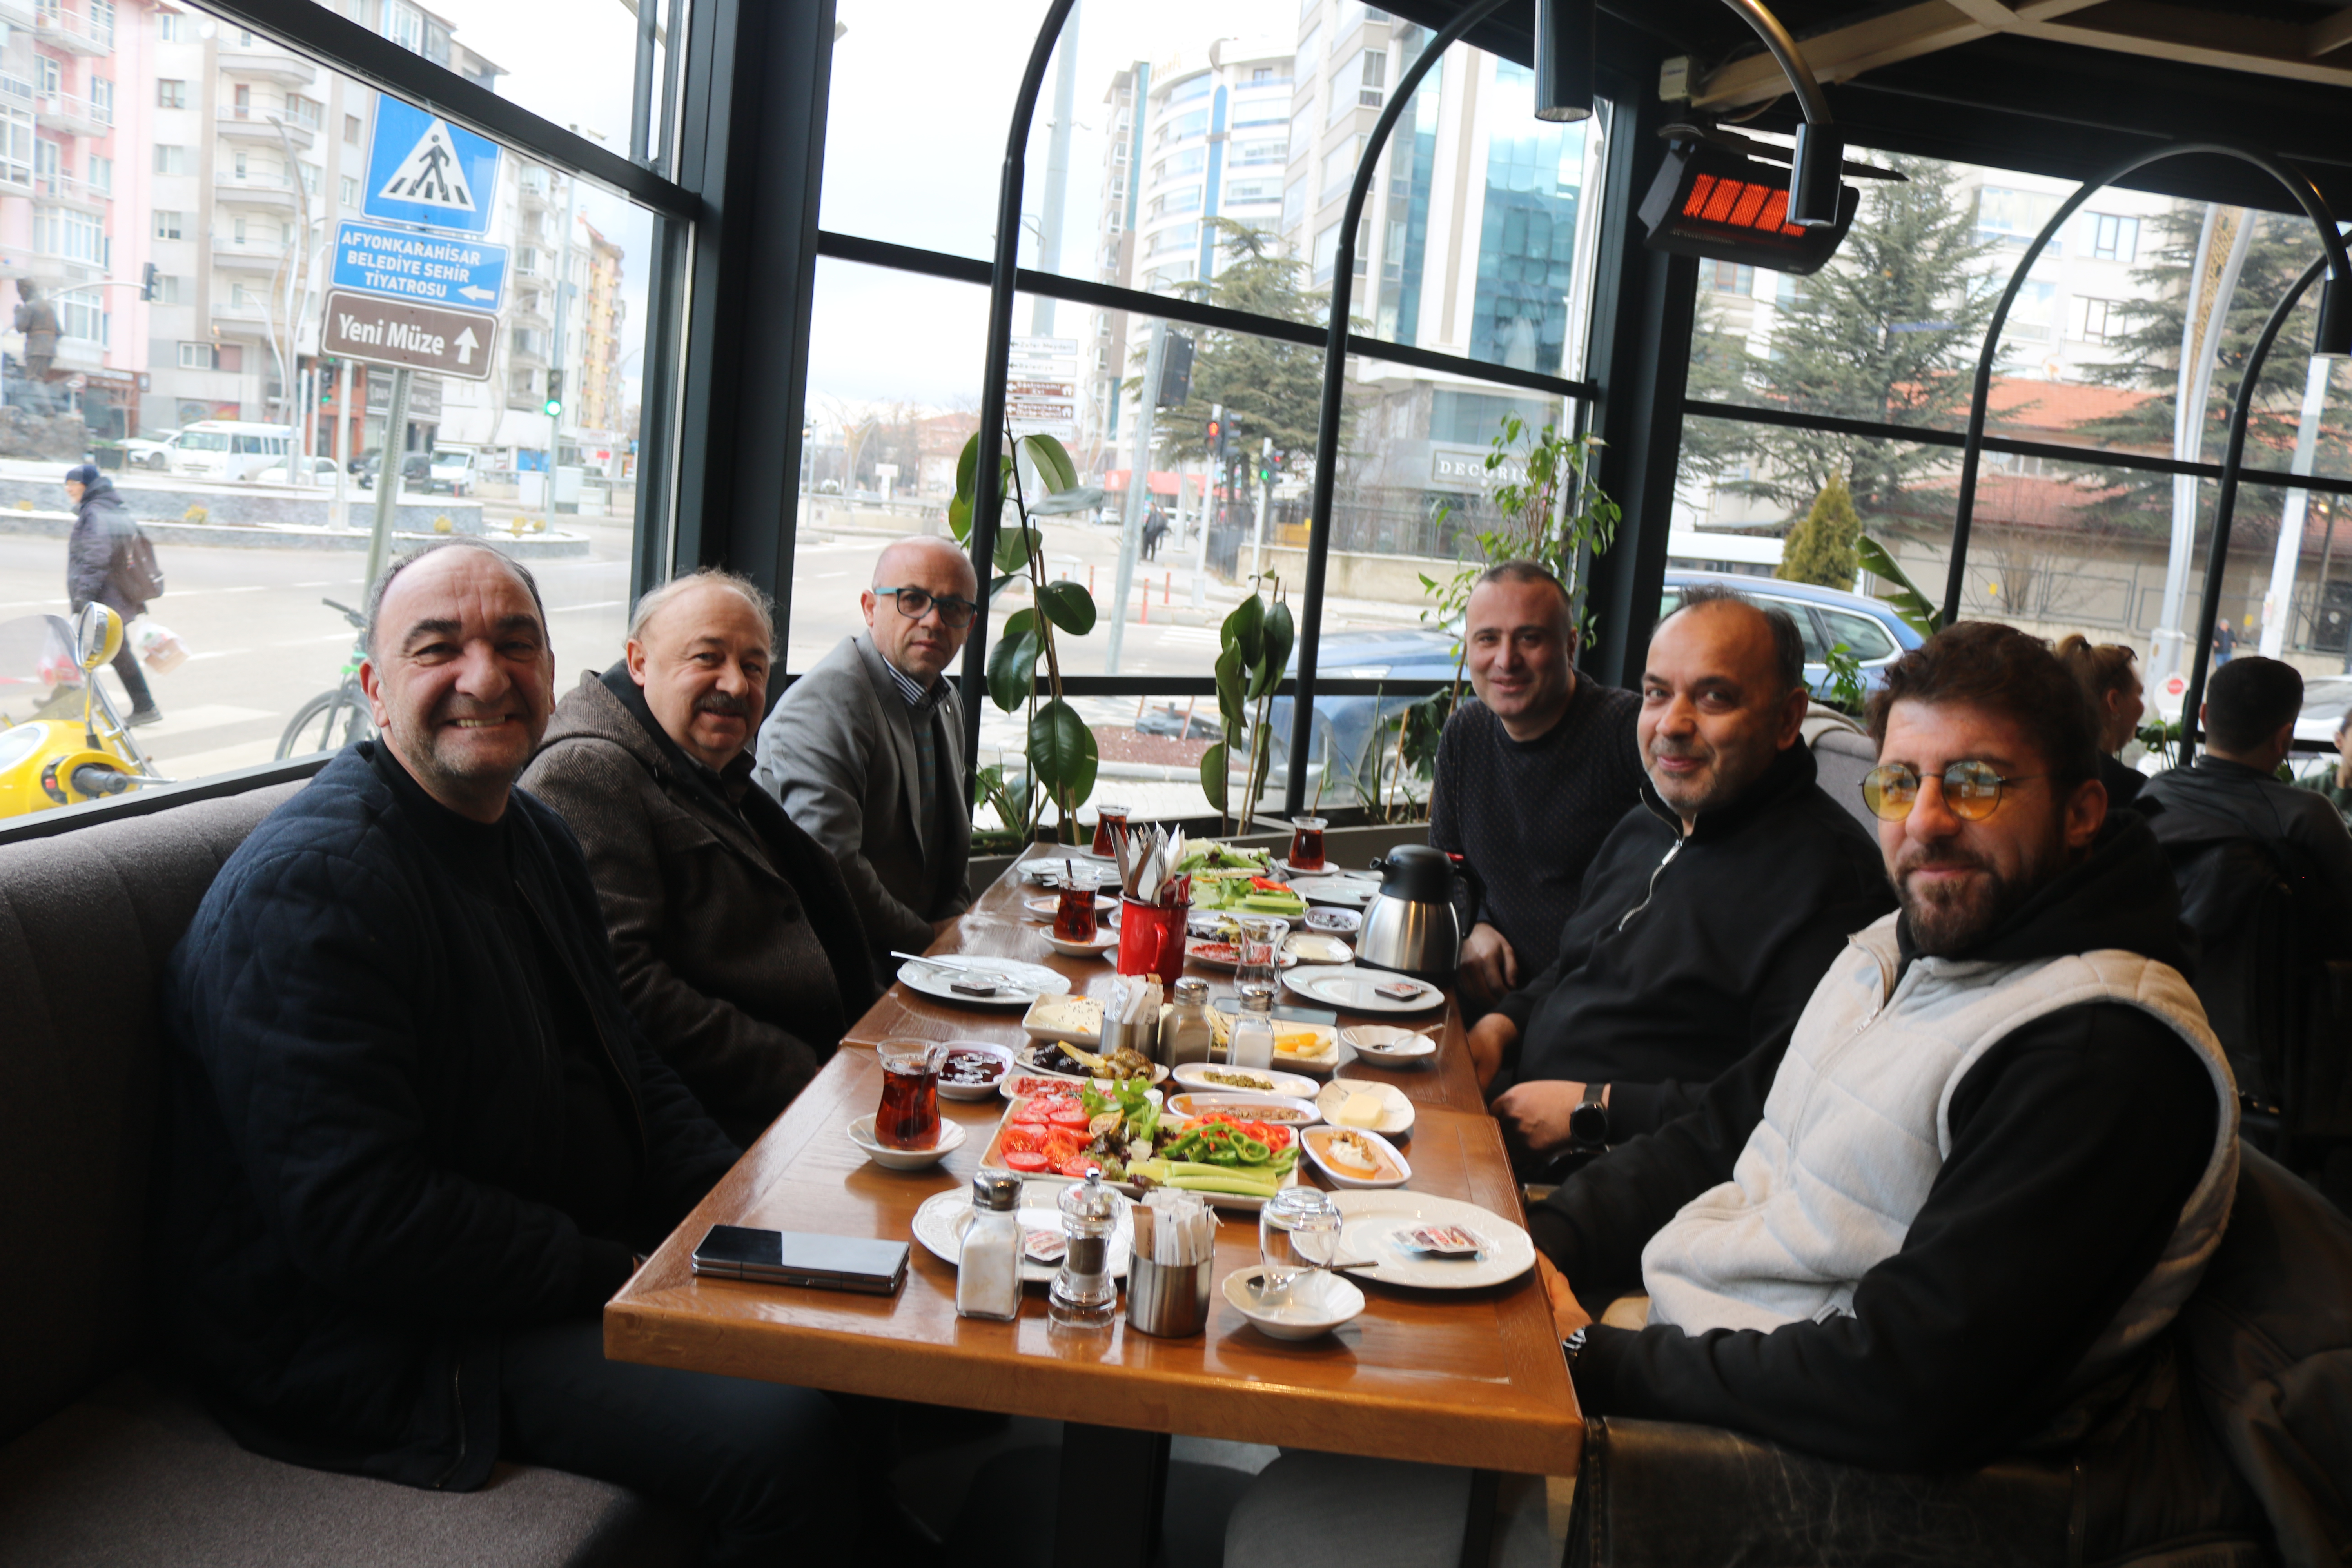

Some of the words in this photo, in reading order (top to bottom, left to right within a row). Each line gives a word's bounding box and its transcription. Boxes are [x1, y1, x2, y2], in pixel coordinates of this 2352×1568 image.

[341, 231, 481, 265] AFYONKARAHİSAR
[347, 250, 422, 275] BELEDİYE
[365, 270, 447, 298] TİYATROSU
[339, 313, 384, 345] Yeni
[386, 321, 445, 355] Müze
